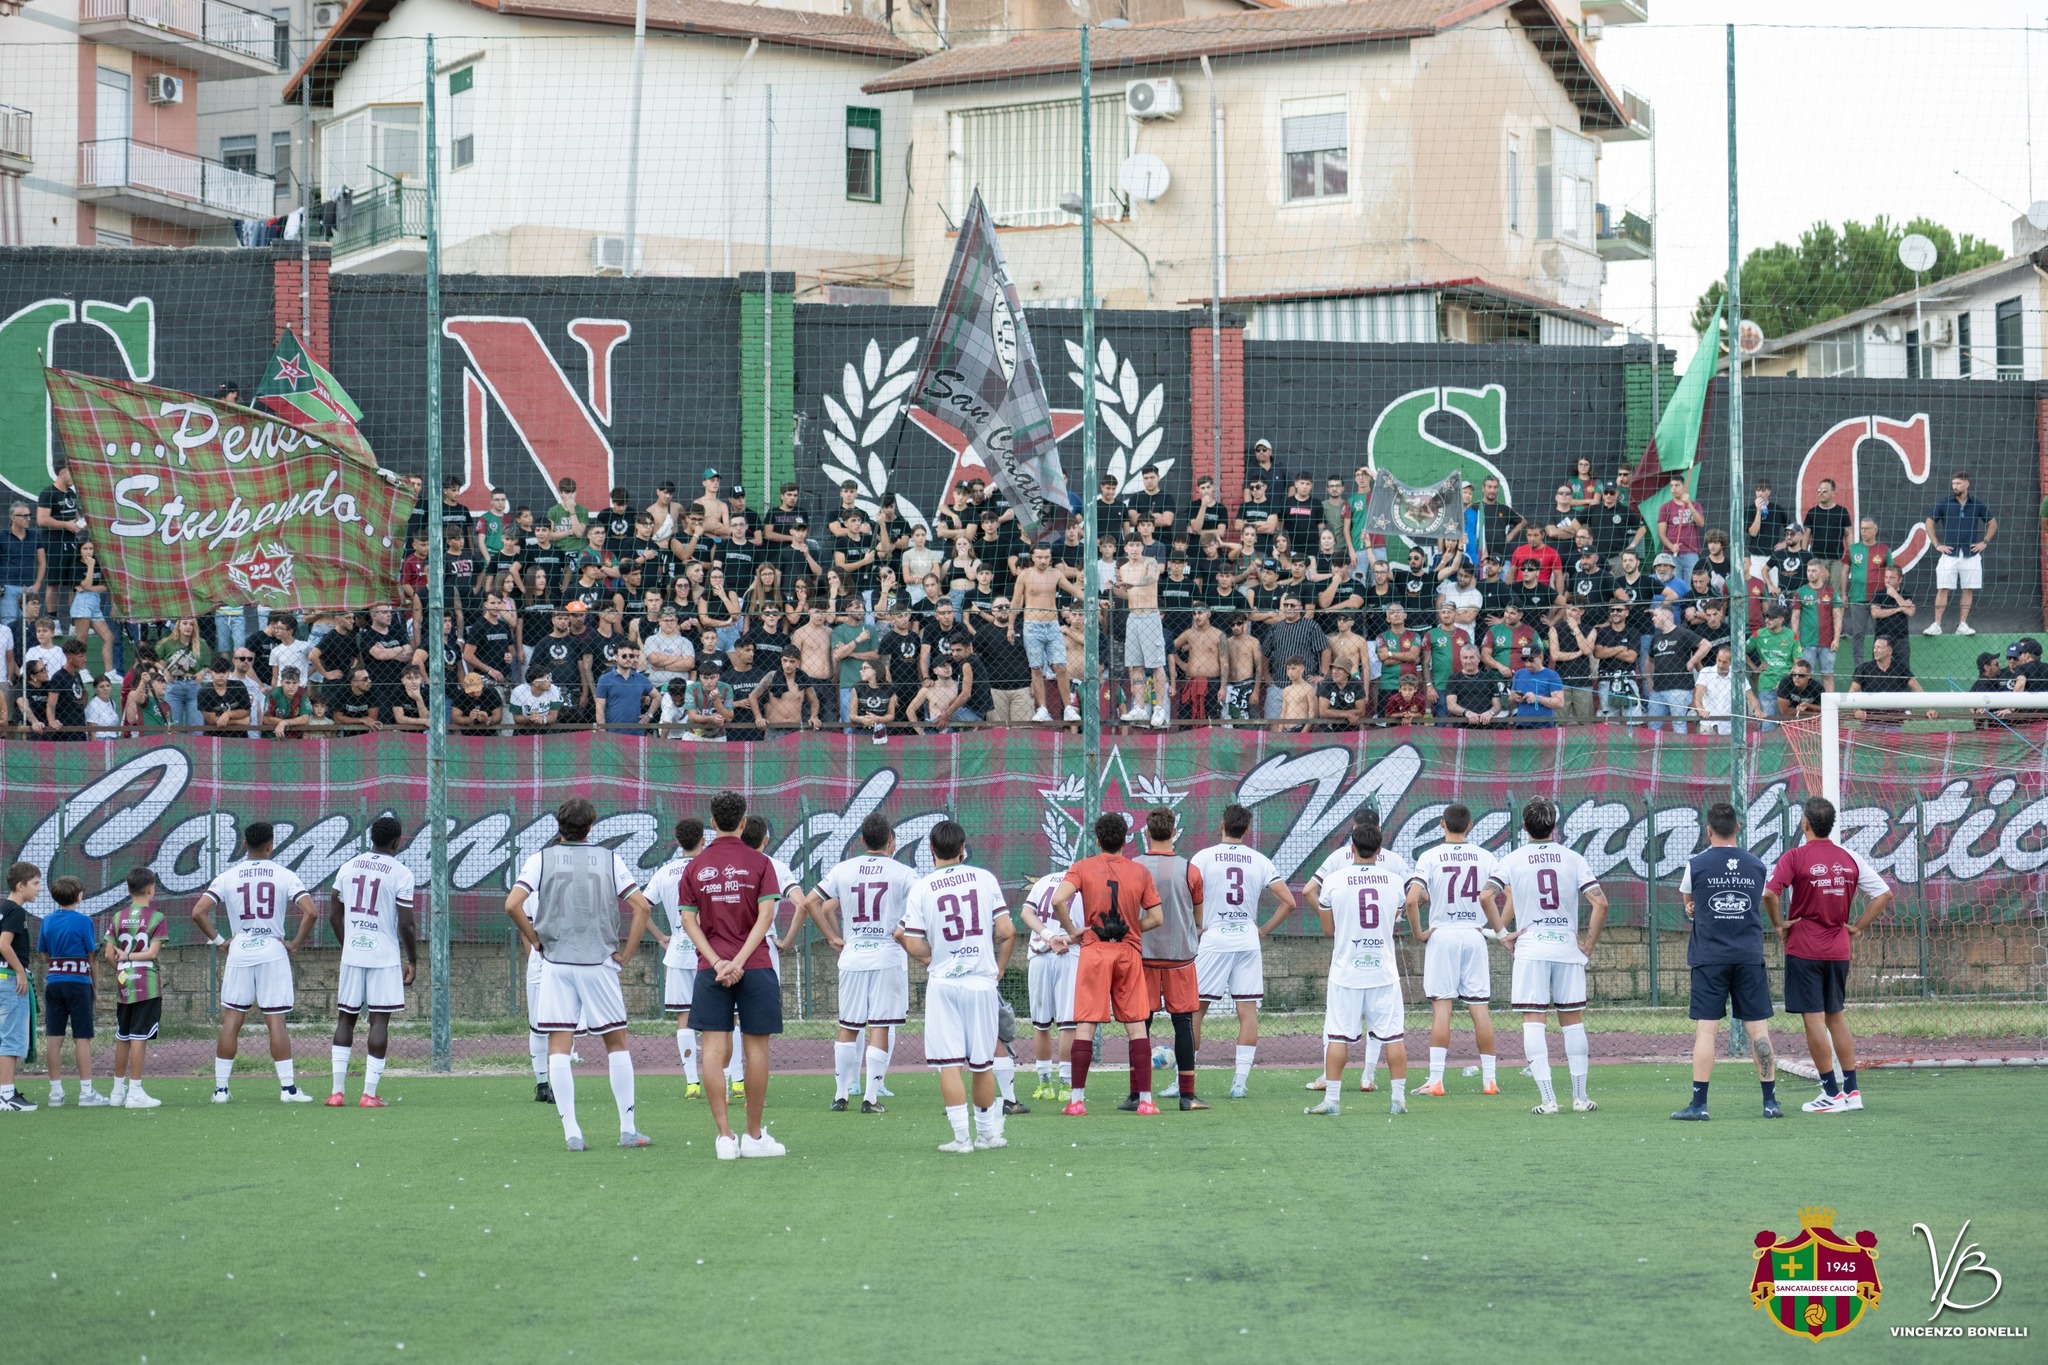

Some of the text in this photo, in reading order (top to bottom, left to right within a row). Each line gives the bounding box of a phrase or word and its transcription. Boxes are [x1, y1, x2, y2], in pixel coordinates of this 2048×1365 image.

[923, 369, 990, 424] San
[442, 314, 632, 515] N
[1367, 383, 1513, 573] S
[1796, 412, 1932, 575] C
[249, 562, 273, 580] 22
[1215, 853, 1252, 864] FERRIGNO
[1439, 853, 1479, 862] LO IACONO
[1528, 853, 1562, 865] CASTRO
[239, 867, 274, 879] CAETANO
[859, 865, 884, 875] ROZZI
[930, 872, 977, 892] BRASOLIN
[1226, 867, 1244, 906] 3
[1347, 875, 1389, 886] GERMANO
[1442, 865, 1481, 904] 74
[1537, 868, 1560, 911] 9
[1731, 876, 1756, 886] FLORA
[236, 881, 276, 921] 19
[350, 874, 382, 917] 11
[851, 881, 889, 923] 17
[1107, 879, 1119, 917] 1
[1358, 888, 1380, 929] 6
[1714, 900, 1746, 911] SPIVER
[937, 888, 984, 942] 31
[1544, 916, 1569, 924] ZODA
[862, 926, 885, 934] ZODA
[957, 946, 980, 955] ODA
[1362, 938, 1384, 946] ZODA
